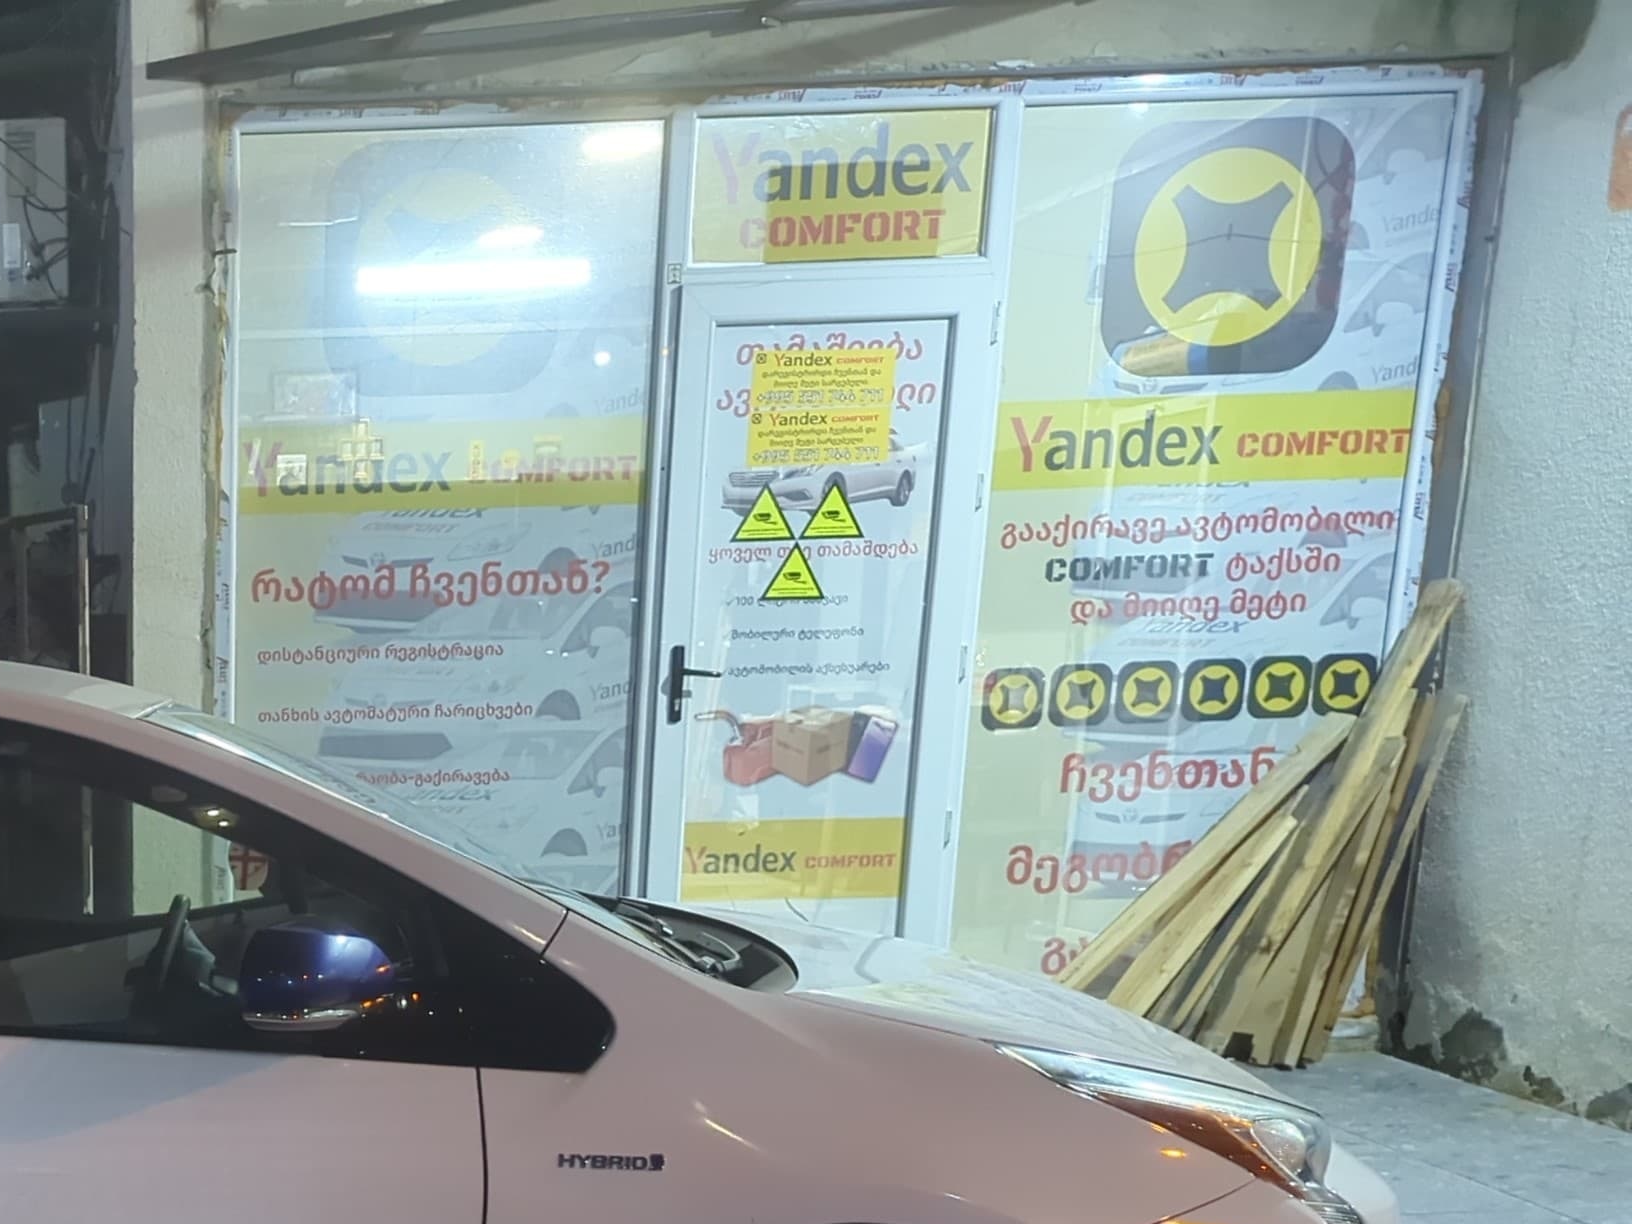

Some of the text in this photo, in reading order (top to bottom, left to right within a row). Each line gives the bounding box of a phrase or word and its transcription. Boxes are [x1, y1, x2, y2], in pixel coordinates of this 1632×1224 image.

[711, 122, 974, 204] Yandex
[739, 209, 945, 249] COMFORT
[774, 352, 833, 367] Yandex
[770, 411, 828, 426] Yandex
[1010, 409, 1414, 473] Yandex COMFORT
[1000, 506, 1396, 549] გააქირავე ავტომობილი
[708, 546, 772, 565] ყოველ
[817, 538, 918, 559] თამაშდება
[1044, 547, 1342, 583] COMFORT ტაქსში
[251, 563, 396, 610] რატომ
[409, 559, 611, 607] ჩვენთან?
[1070, 588, 1308, 625] და მიიღე მეტი
[257, 642, 504, 665] დისტანციური რეგისტრაცია
[257, 702, 533, 724] თანხის ავტომატური ჩარიცხვები
[684, 843, 897, 876] Yandex COMFORT
[557, 1153, 648, 1171] HYBRID
